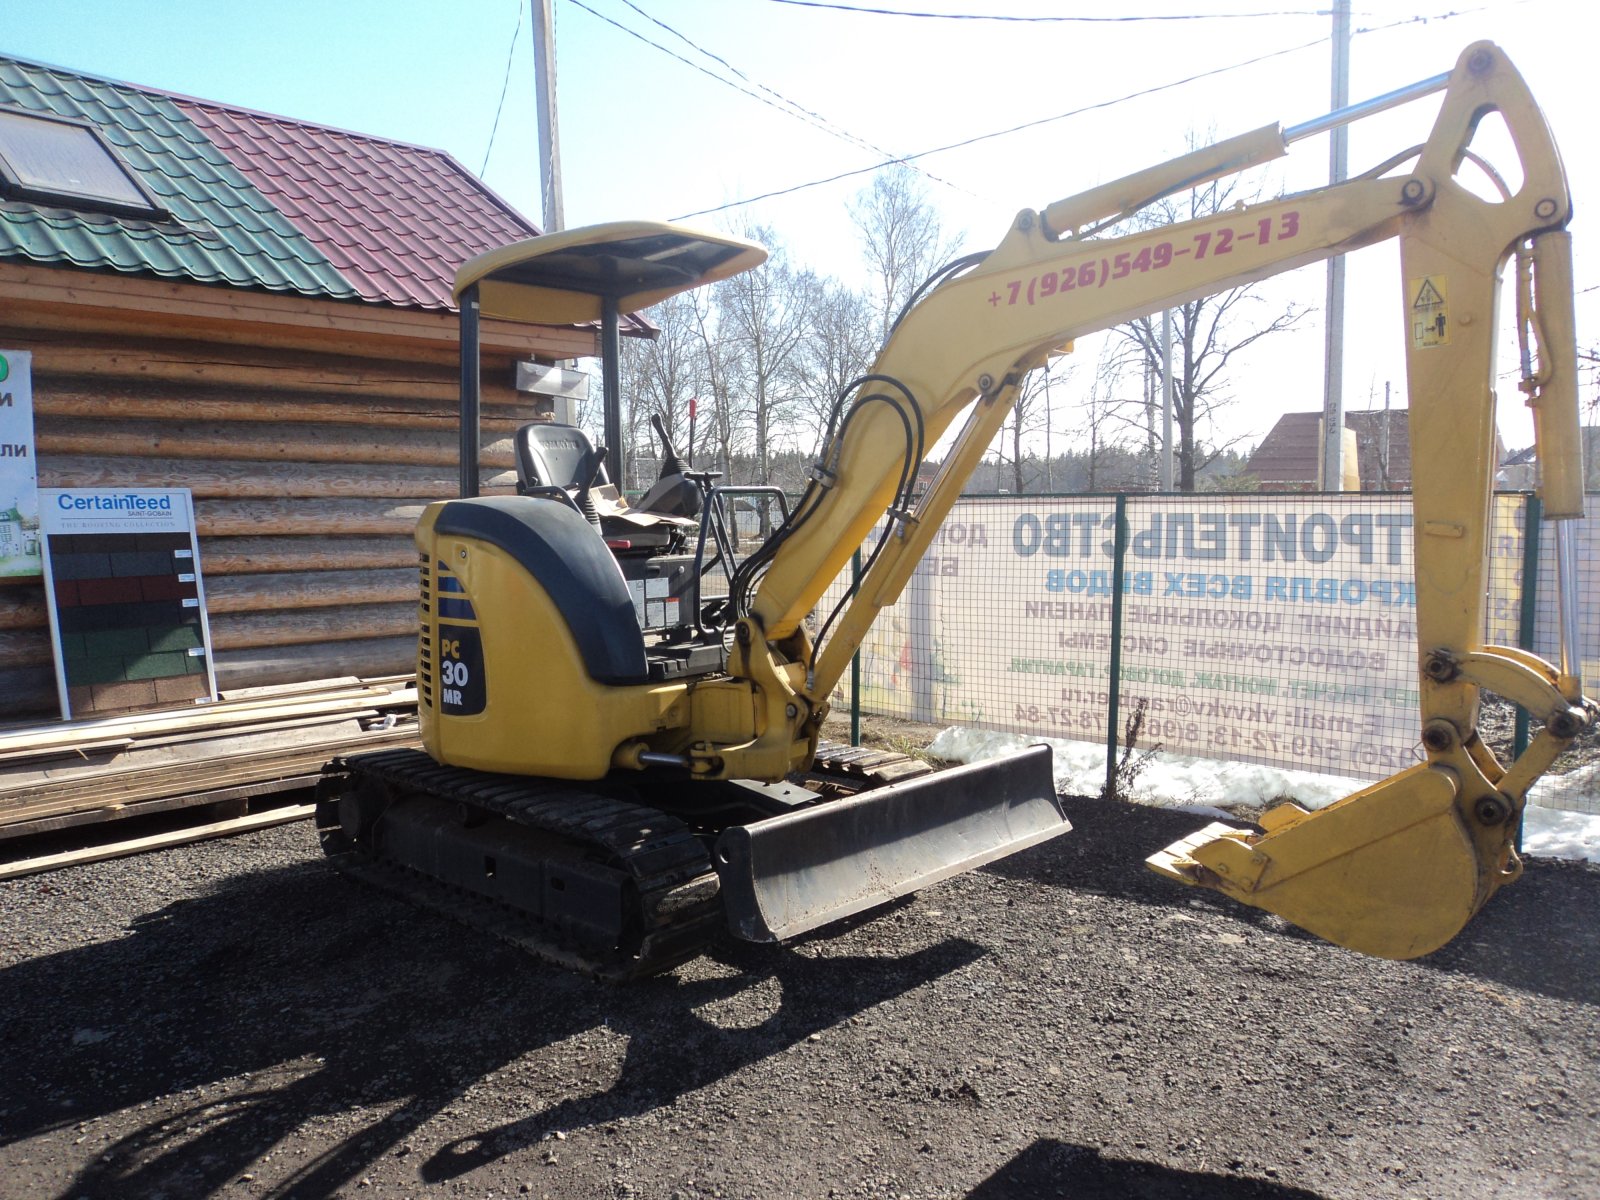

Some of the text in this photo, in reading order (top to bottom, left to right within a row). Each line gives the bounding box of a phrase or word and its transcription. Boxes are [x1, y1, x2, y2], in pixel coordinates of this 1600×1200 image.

[988, 211, 1300, 307] +7(926)549-72-13
[58, 494, 171, 510] CertainTeed
[441, 639, 460, 659] PC
[442, 660, 468, 687] 30
[443, 688, 462, 706] MR
